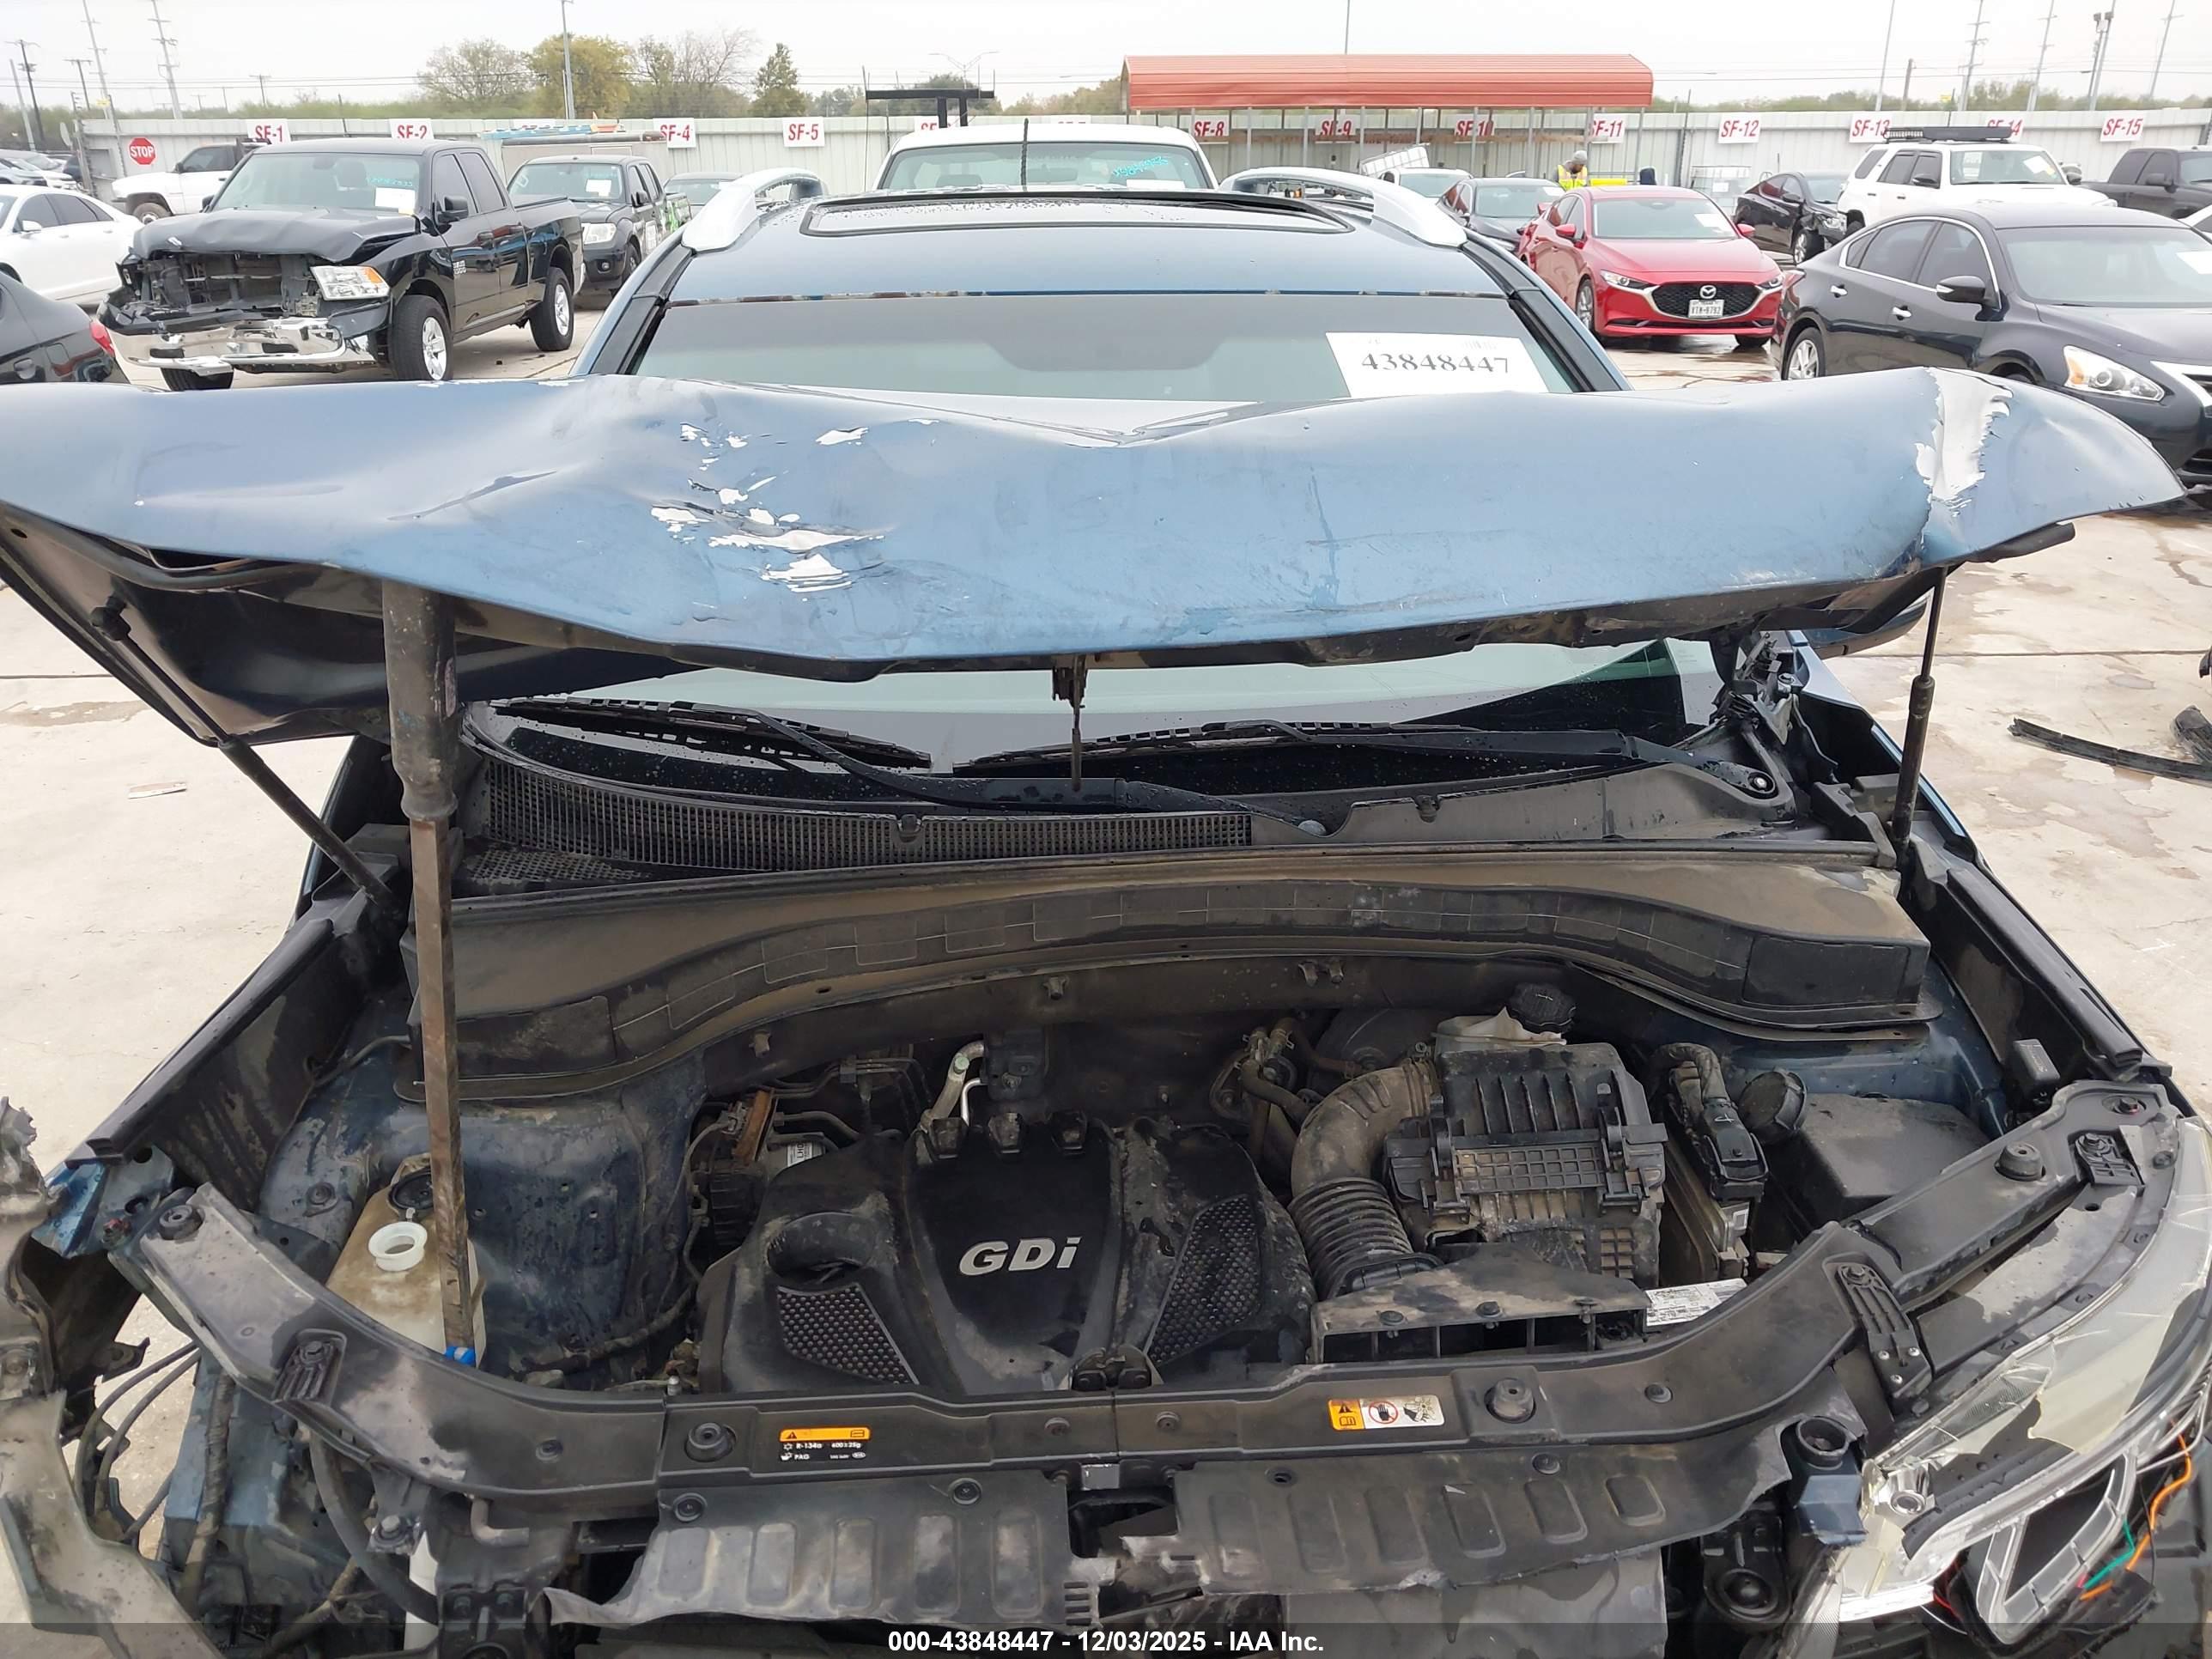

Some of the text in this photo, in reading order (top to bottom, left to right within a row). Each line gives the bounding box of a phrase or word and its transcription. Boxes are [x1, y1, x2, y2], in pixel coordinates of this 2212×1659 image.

[255, 125, 283, 143] SF-1
[397, 125, 428, 139] SF-2
[659, 124, 690, 142] SF-4
[788, 123, 819, 141] SF-5
[1194, 121, 1224, 137] SF-8
[1721, 119, 1759, 137] SF-12
[2103, 118, 2143, 136] SF-15
[130, 145, 155, 158] STOP
[1362, 352, 1508, 374] 43848447
[959, 1237, 1082, 1276] GDi
